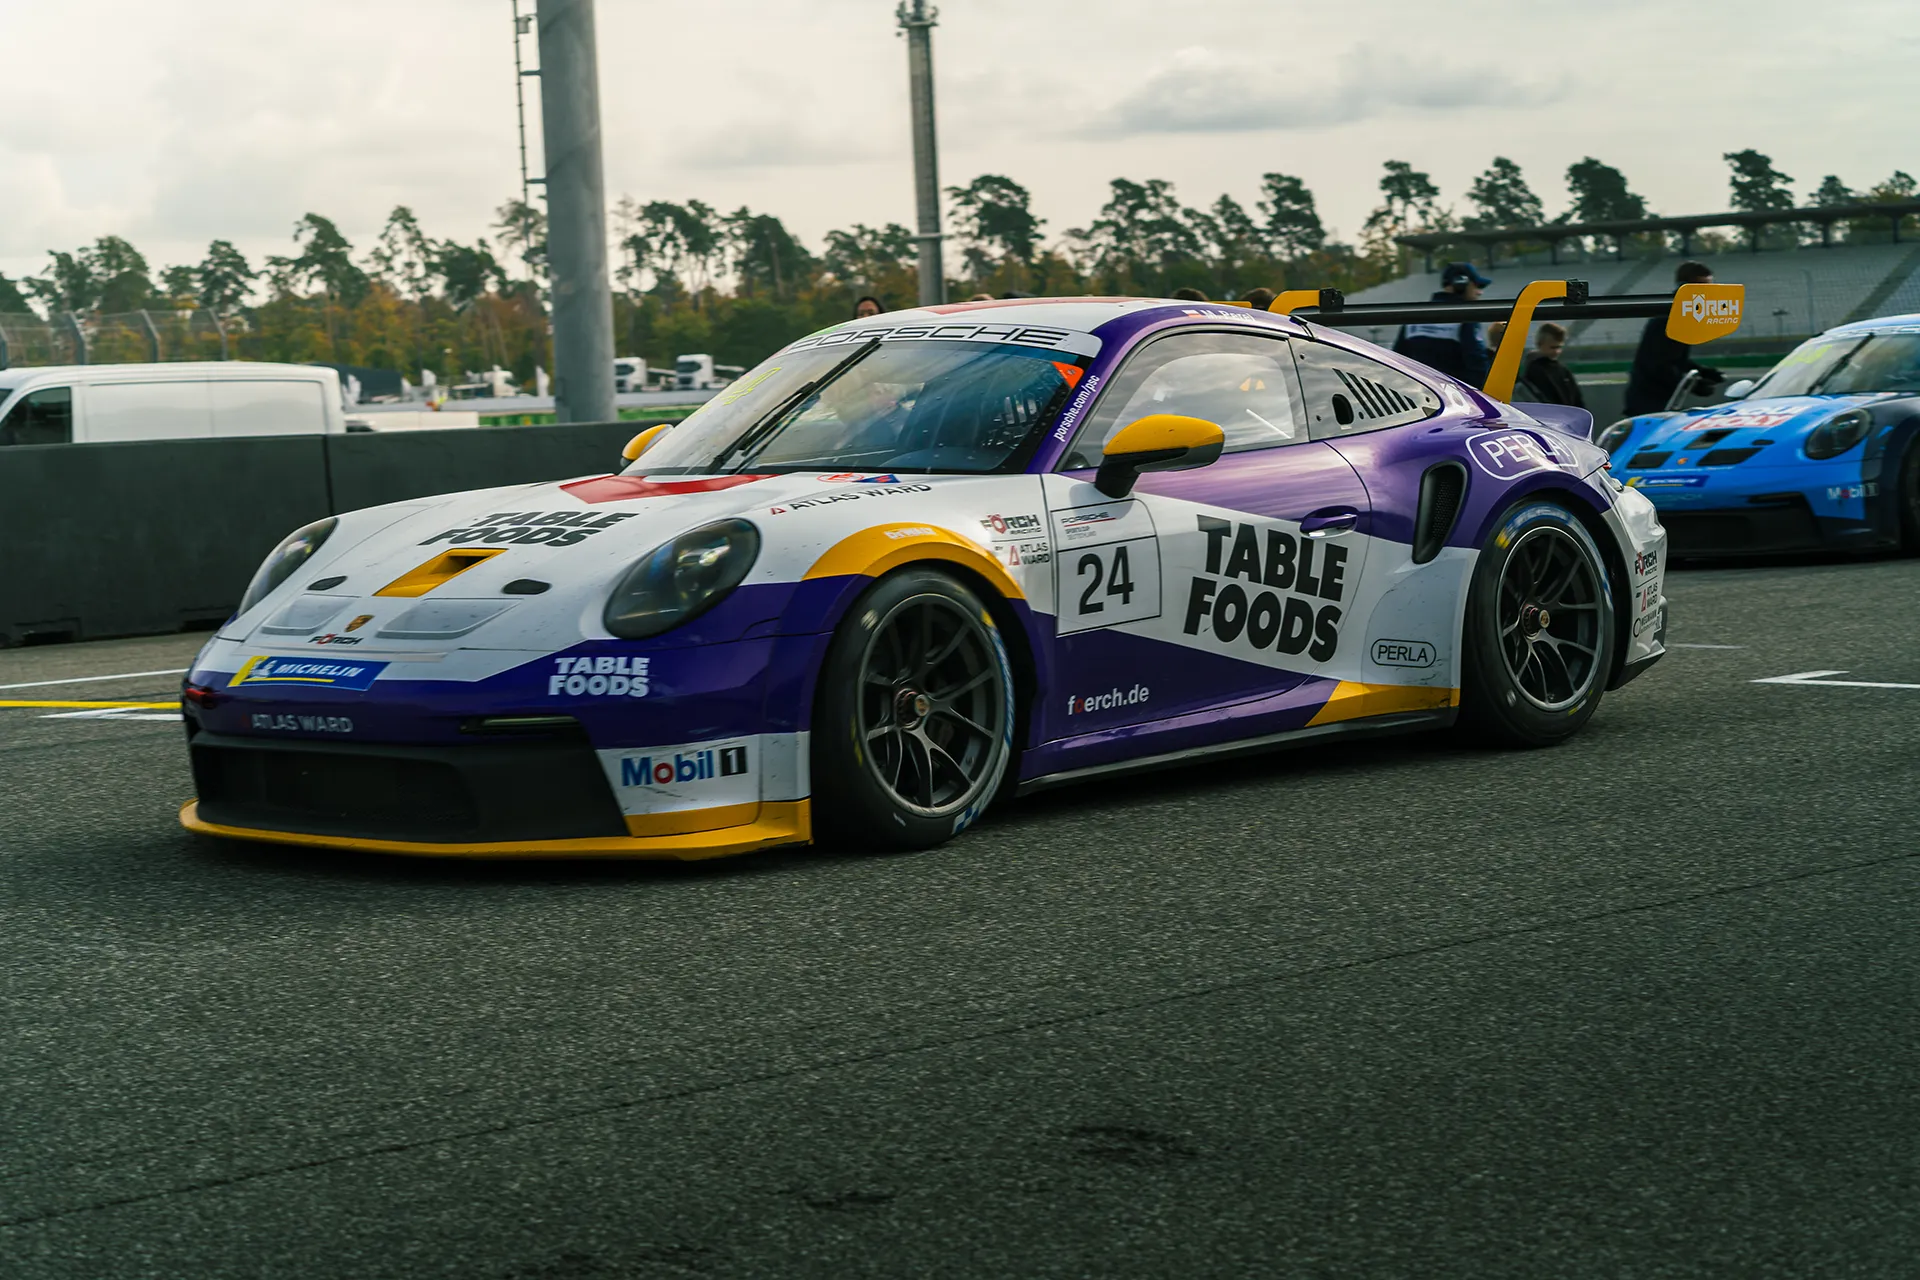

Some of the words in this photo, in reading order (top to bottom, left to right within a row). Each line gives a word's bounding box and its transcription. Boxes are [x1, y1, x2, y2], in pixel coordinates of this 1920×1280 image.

[1706, 317, 1739, 325] RACING
[790, 325, 1070, 350] PORSCHE
[1053, 375, 1100, 443] porsche.com/psc
[1480, 434, 1571, 469] PERLA
[789, 492, 861, 510] ATLAS
[857, 483, 932, 498] WARD
[470, 511, 640, 528] TABLE
[416, 527, 602, 547] FOODS
[1020, 542, 1049, 554] ATLAS
[1021, 553, 1050, 566] WARD
[1196, 514, 1348, 602] TABLE
[1077, 545, 1134, 615] 24
[1183, 576, 1343, 663] FOODS
[1377, 645, 1428, 663] PERLA
[273, 663, 365, 677] MICHELIN
[554, 656, 651, 676] TABLE
[548, 674, 650, 697] FOODS
[1067, 683, 1150, 716] foerch.de
[252, 713, 299, 731] ATLAS
[298, 715, 353, 733] WARD
[622, 750, 715, 786] Mobil
